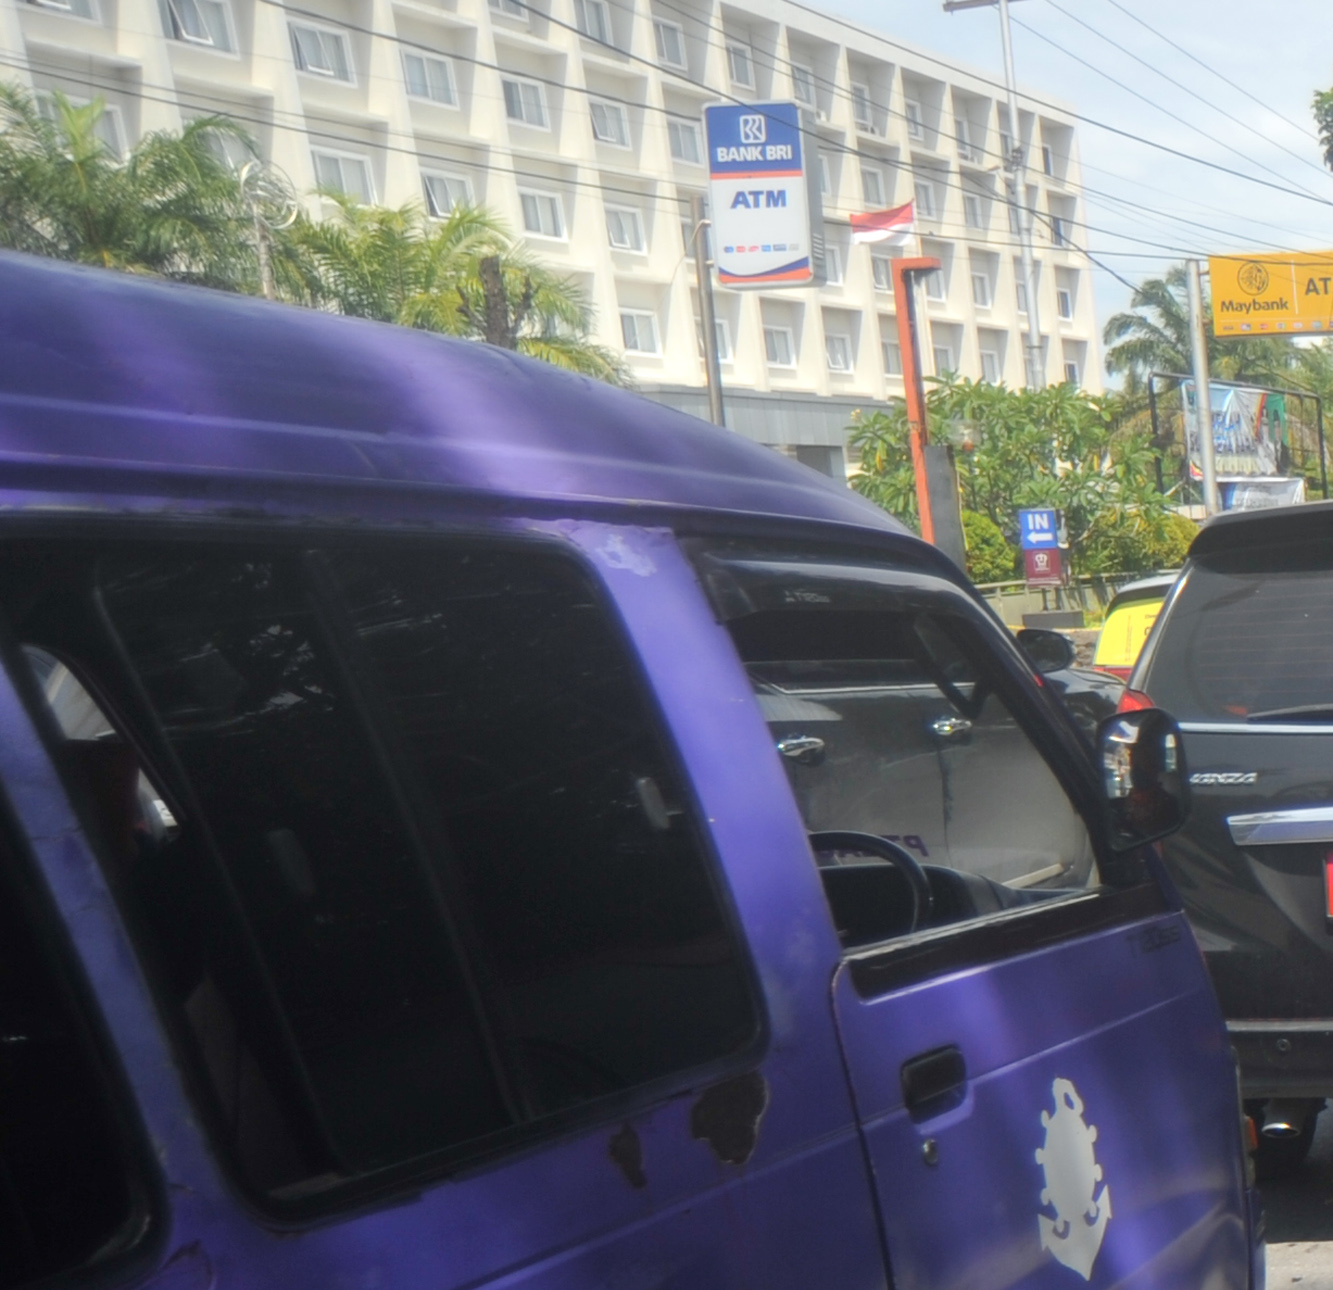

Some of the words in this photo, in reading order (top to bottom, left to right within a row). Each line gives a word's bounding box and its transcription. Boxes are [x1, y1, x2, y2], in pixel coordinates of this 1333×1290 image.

[717, 147, 763, 162] BANK
[766, 145, 792, 160] BRI
[731, 190, 786, 209] ATM
[1221, 297, 1288, 314] Maybank
[1028, 514, 1049, 530] IN
